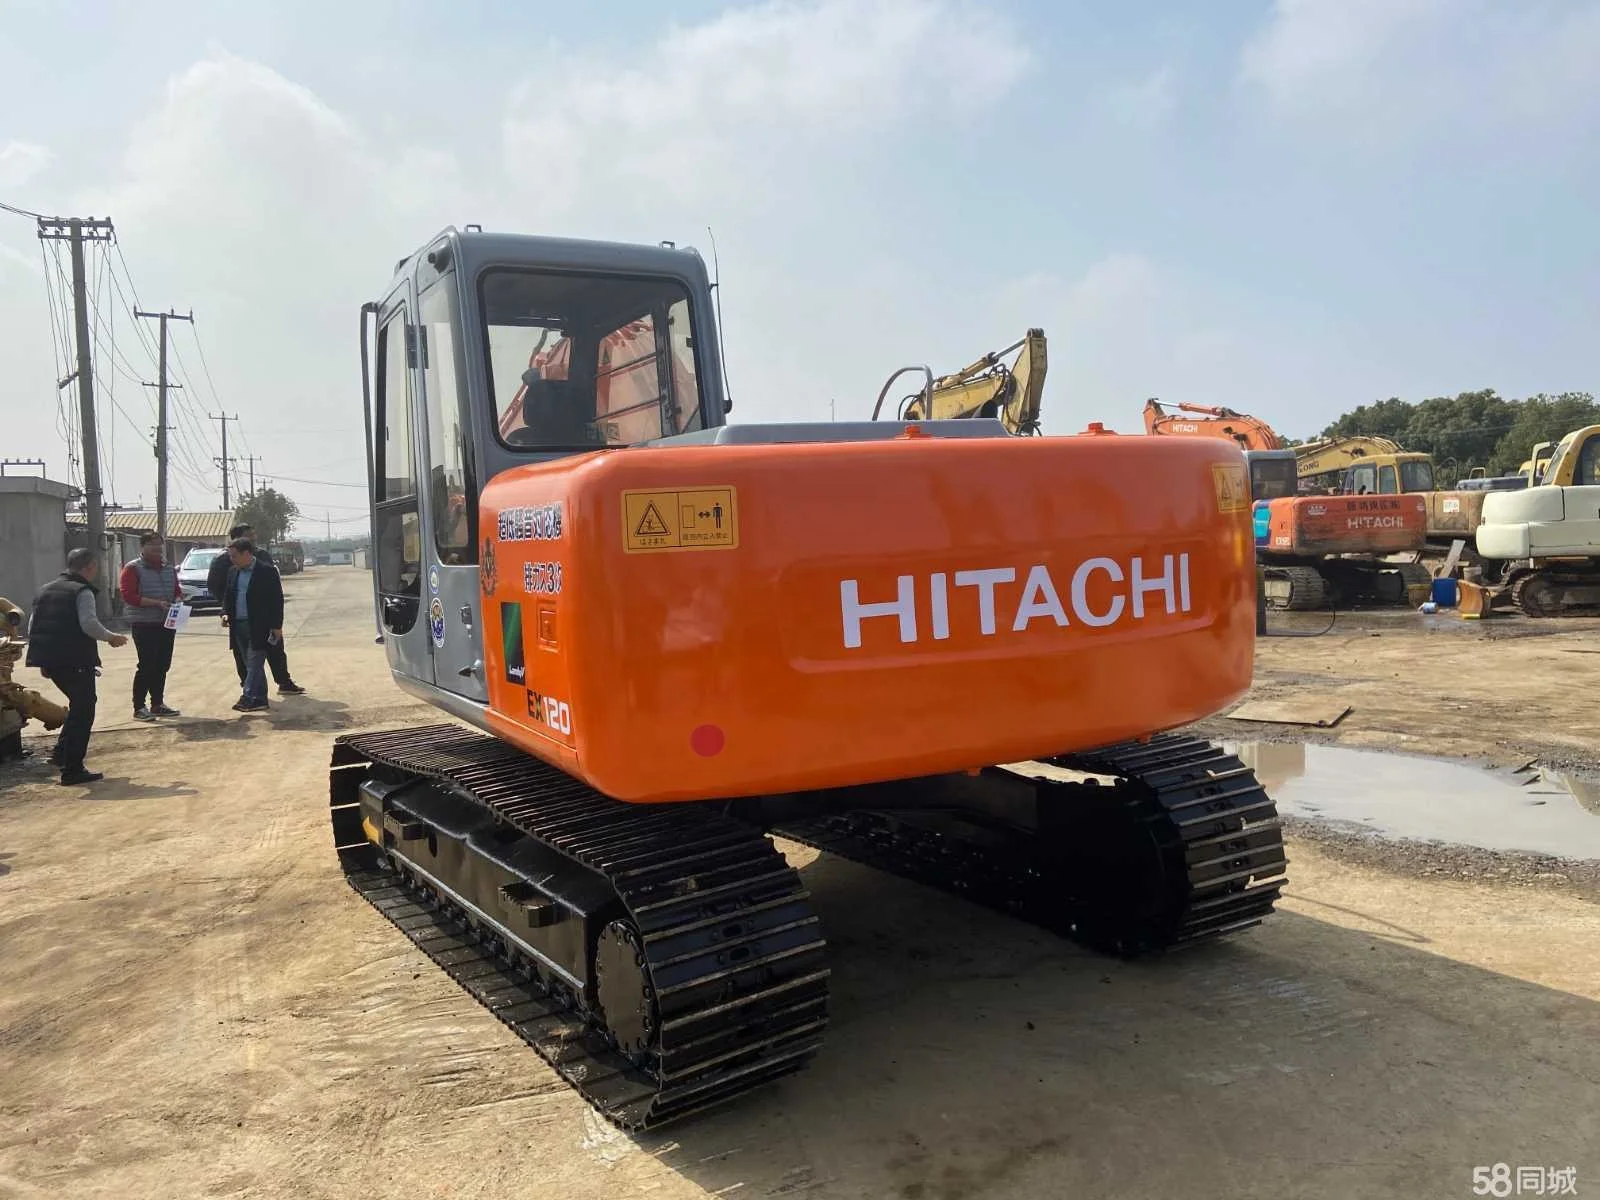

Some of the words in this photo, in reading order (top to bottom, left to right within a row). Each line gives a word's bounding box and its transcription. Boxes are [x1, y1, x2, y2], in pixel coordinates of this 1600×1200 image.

[1172, 423, 1198, 433] HITACHI
[1347, 516, 1403, 529] HITACHI
[840, 552, 1191, 649] HITACHI
